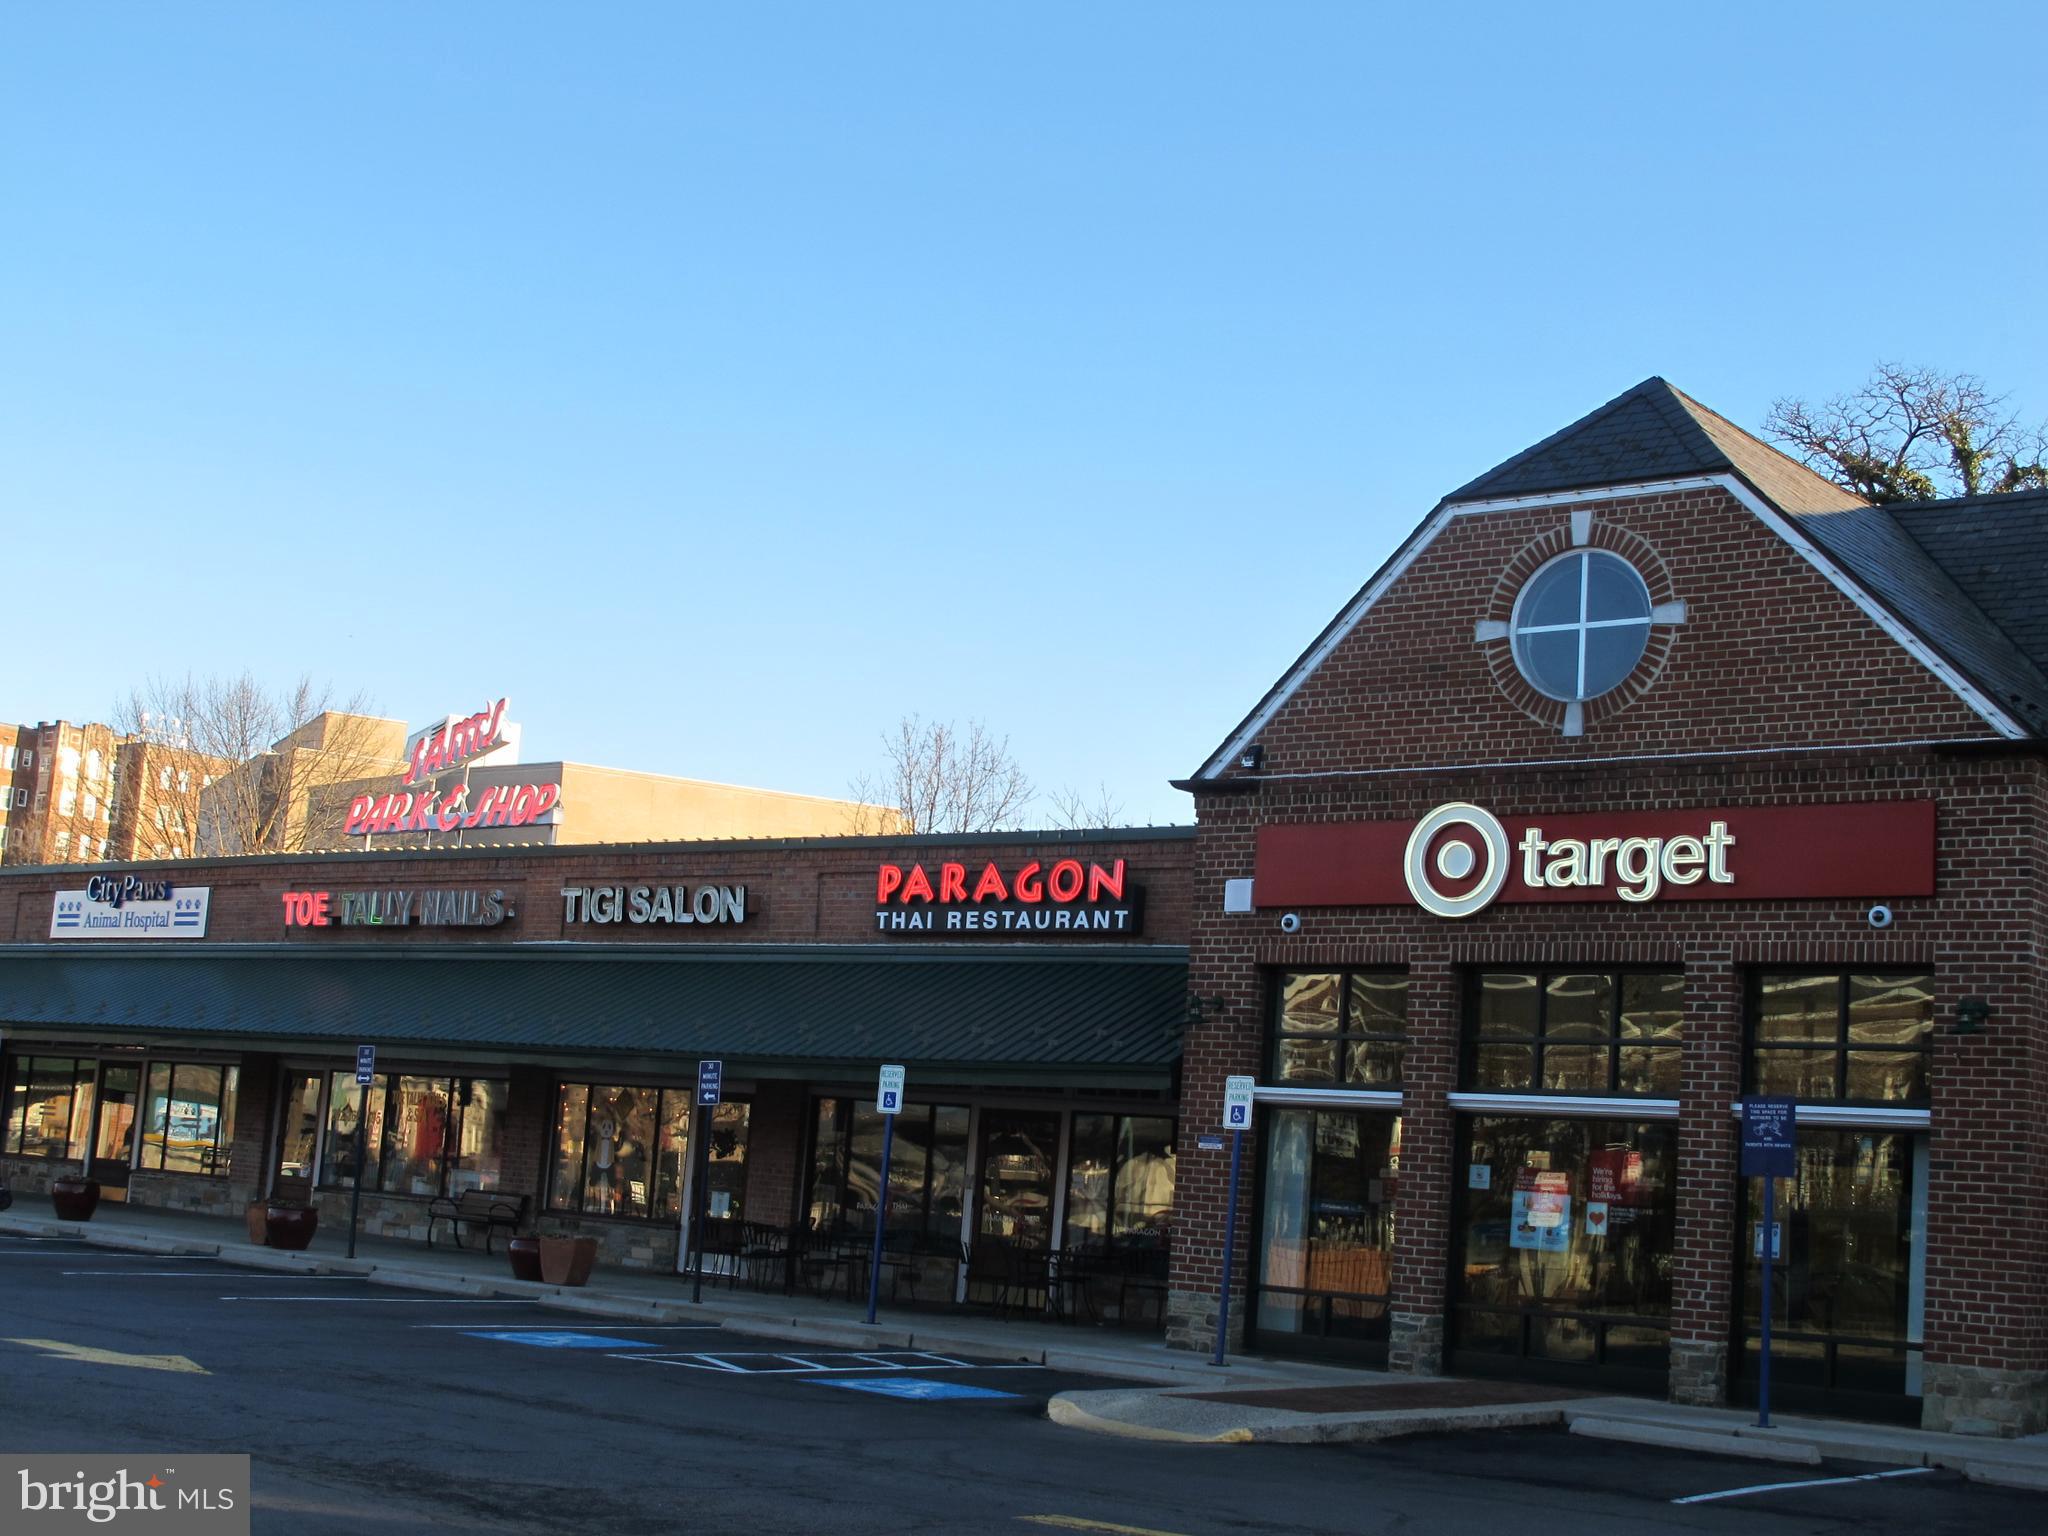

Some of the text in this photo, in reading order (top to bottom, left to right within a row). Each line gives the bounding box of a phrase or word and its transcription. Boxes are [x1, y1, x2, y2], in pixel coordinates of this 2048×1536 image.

[343, 783, 560, 833] PARK & SHOP
[1519, 821, 1736, 902] target
[877, 858, 1125, 904] PARAGON
[282, 889, 504, 926] TOE TALLY NAILS
[560, 885, 745, 924] TIGI SALON
[83, 910, 170, 932] Animal Hospital
[876, 910, 1129, 930] THAI RESTAURANT
[1228, 1080, 1253, 1090] RESERVED
[1228, 1093, 1249, 1102] PARKING
[1592, 1167, 1613, 1176] We're
[1592, 1175, 1613, 1184] hiring
